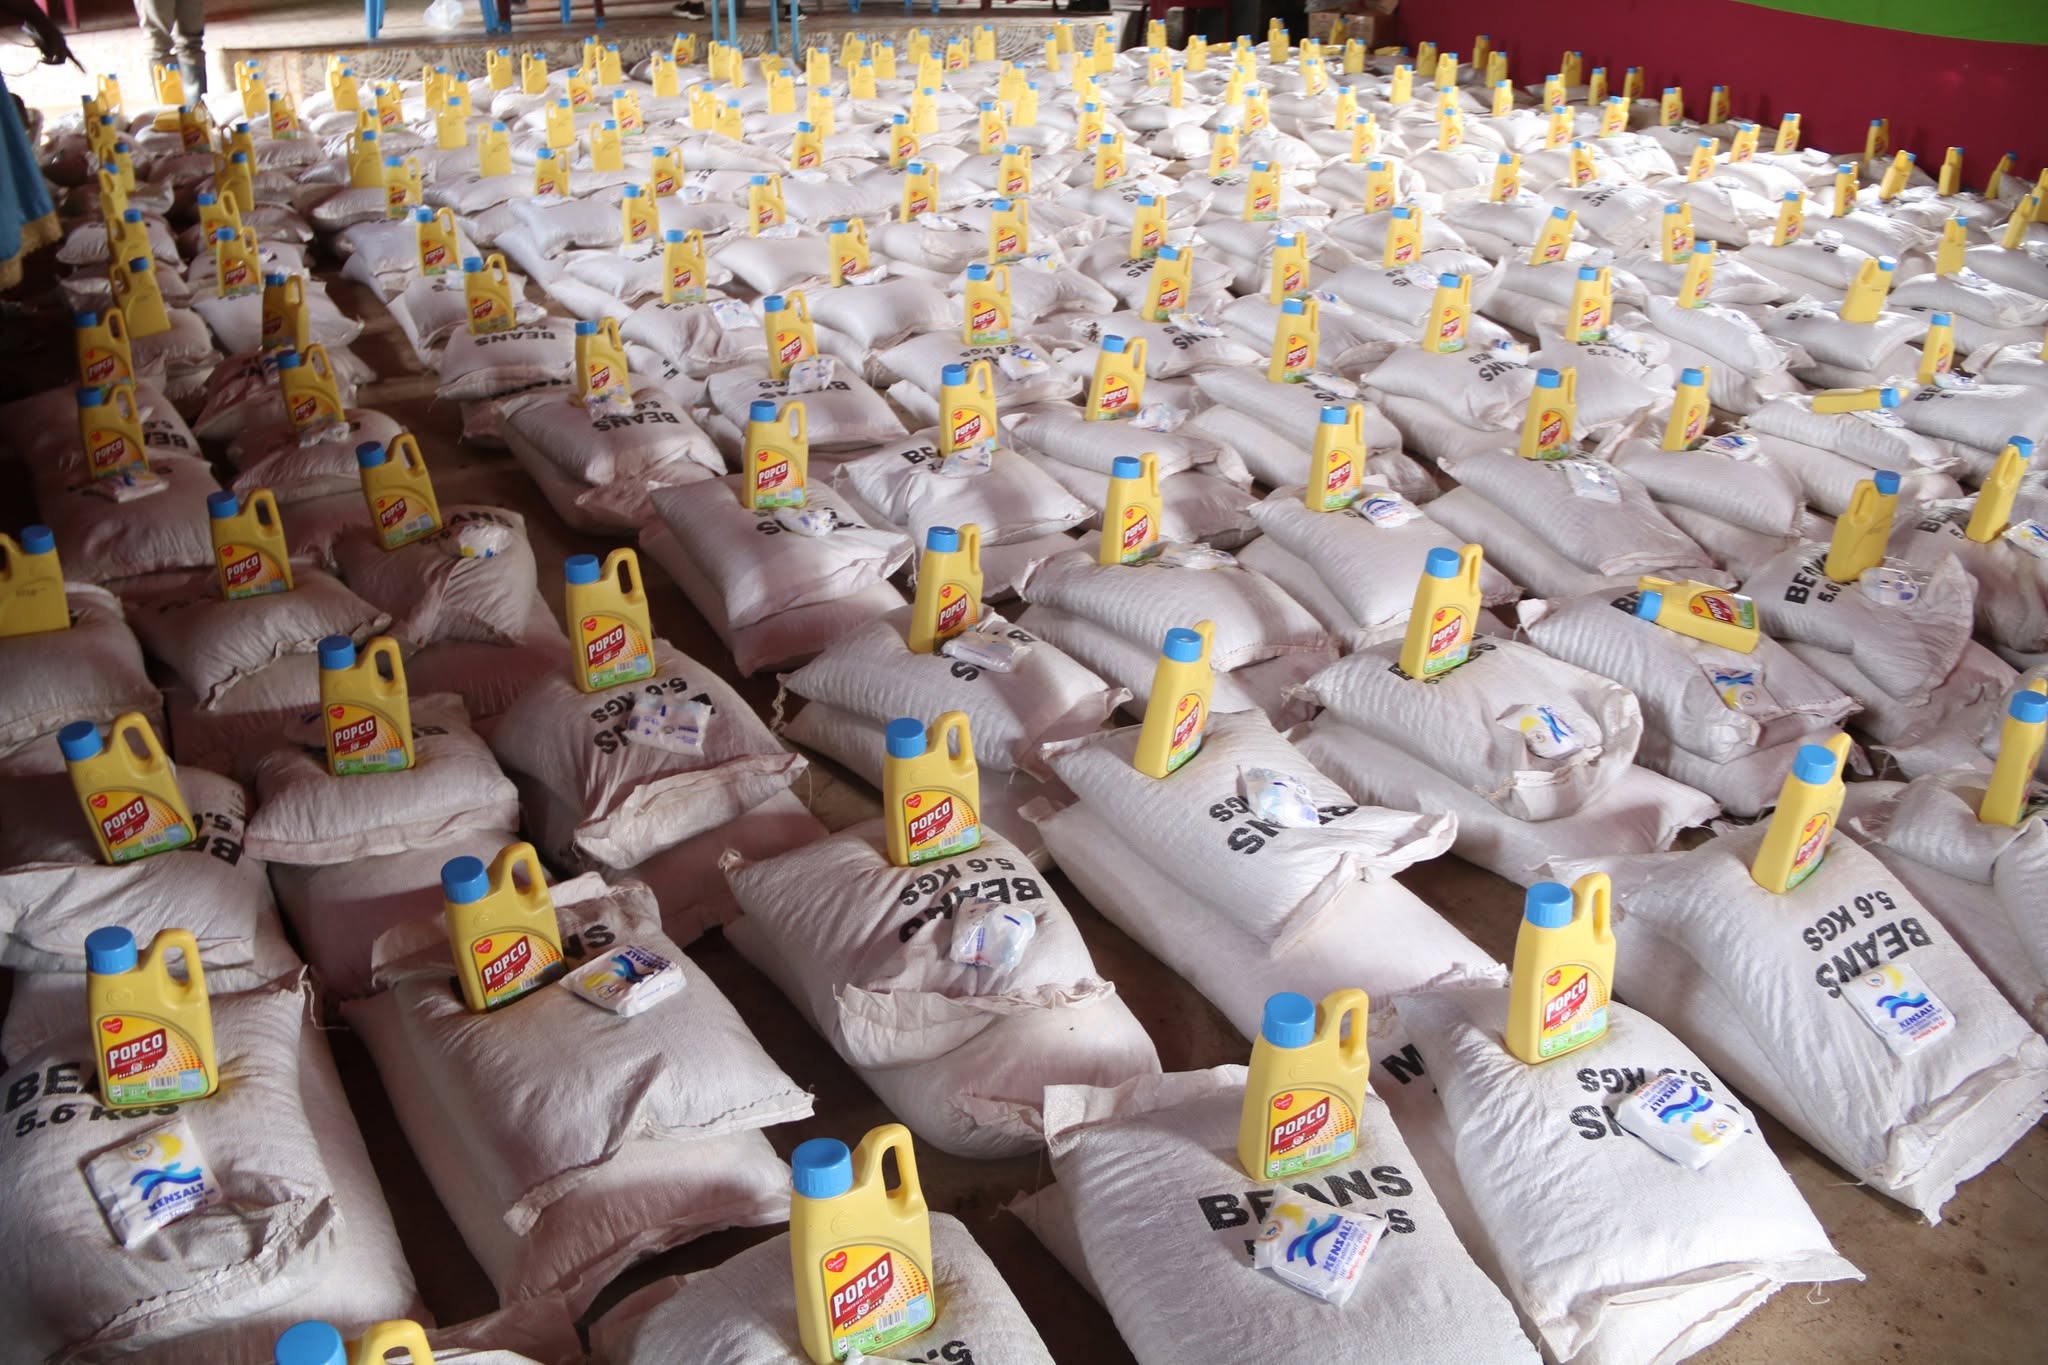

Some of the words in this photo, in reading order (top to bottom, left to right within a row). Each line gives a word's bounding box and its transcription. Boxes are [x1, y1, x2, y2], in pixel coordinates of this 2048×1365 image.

[592, 411, 680, 432] BEANS
[759, 463, 787, 485] POPCO
[381, 501, 406, 523] POPCO
[226, 555, 260, 581] POPCO
[940, 598, 966, 626] POPCO
[589, 628, 624, 660] POPCO
[1431, 617, 1461, 648] POPCO
[334, 719, 375, 748] POPCO
[103, 799, 145, 838] POPCO
[911, 801, 951, 838] POPCO
[1209, 795, 1250, 823] GS
[966, 857, 1016, 874] 5.6
[900, 863, 963, 906] KGS
[1854, 890, 1897, 919] 5.6
[1802, 904, 1857, 952] KGS
[484, 941, 527, 985] POPCO
[1815, 916, 1934, 999] BEANS
[1545, 977, 1587, 1024] POPCO
[1898, 1003, 1936, 1029] KENSALT
[109, 1033, 163, 1070] POPCO
[1576, 1067, 1646, 1096] KGS
[1649, 1076, 1688, 1113] KENSALT
[15, 1103, 77, 1138] 5.6
[1273, 1103, 1327, 1146] POPCO
[147, 1182, 205, 1213] KENSALT
[1323, 1219, 1354, 1272] KENSALT
[832, 1259, 891, 1319] POPCO
